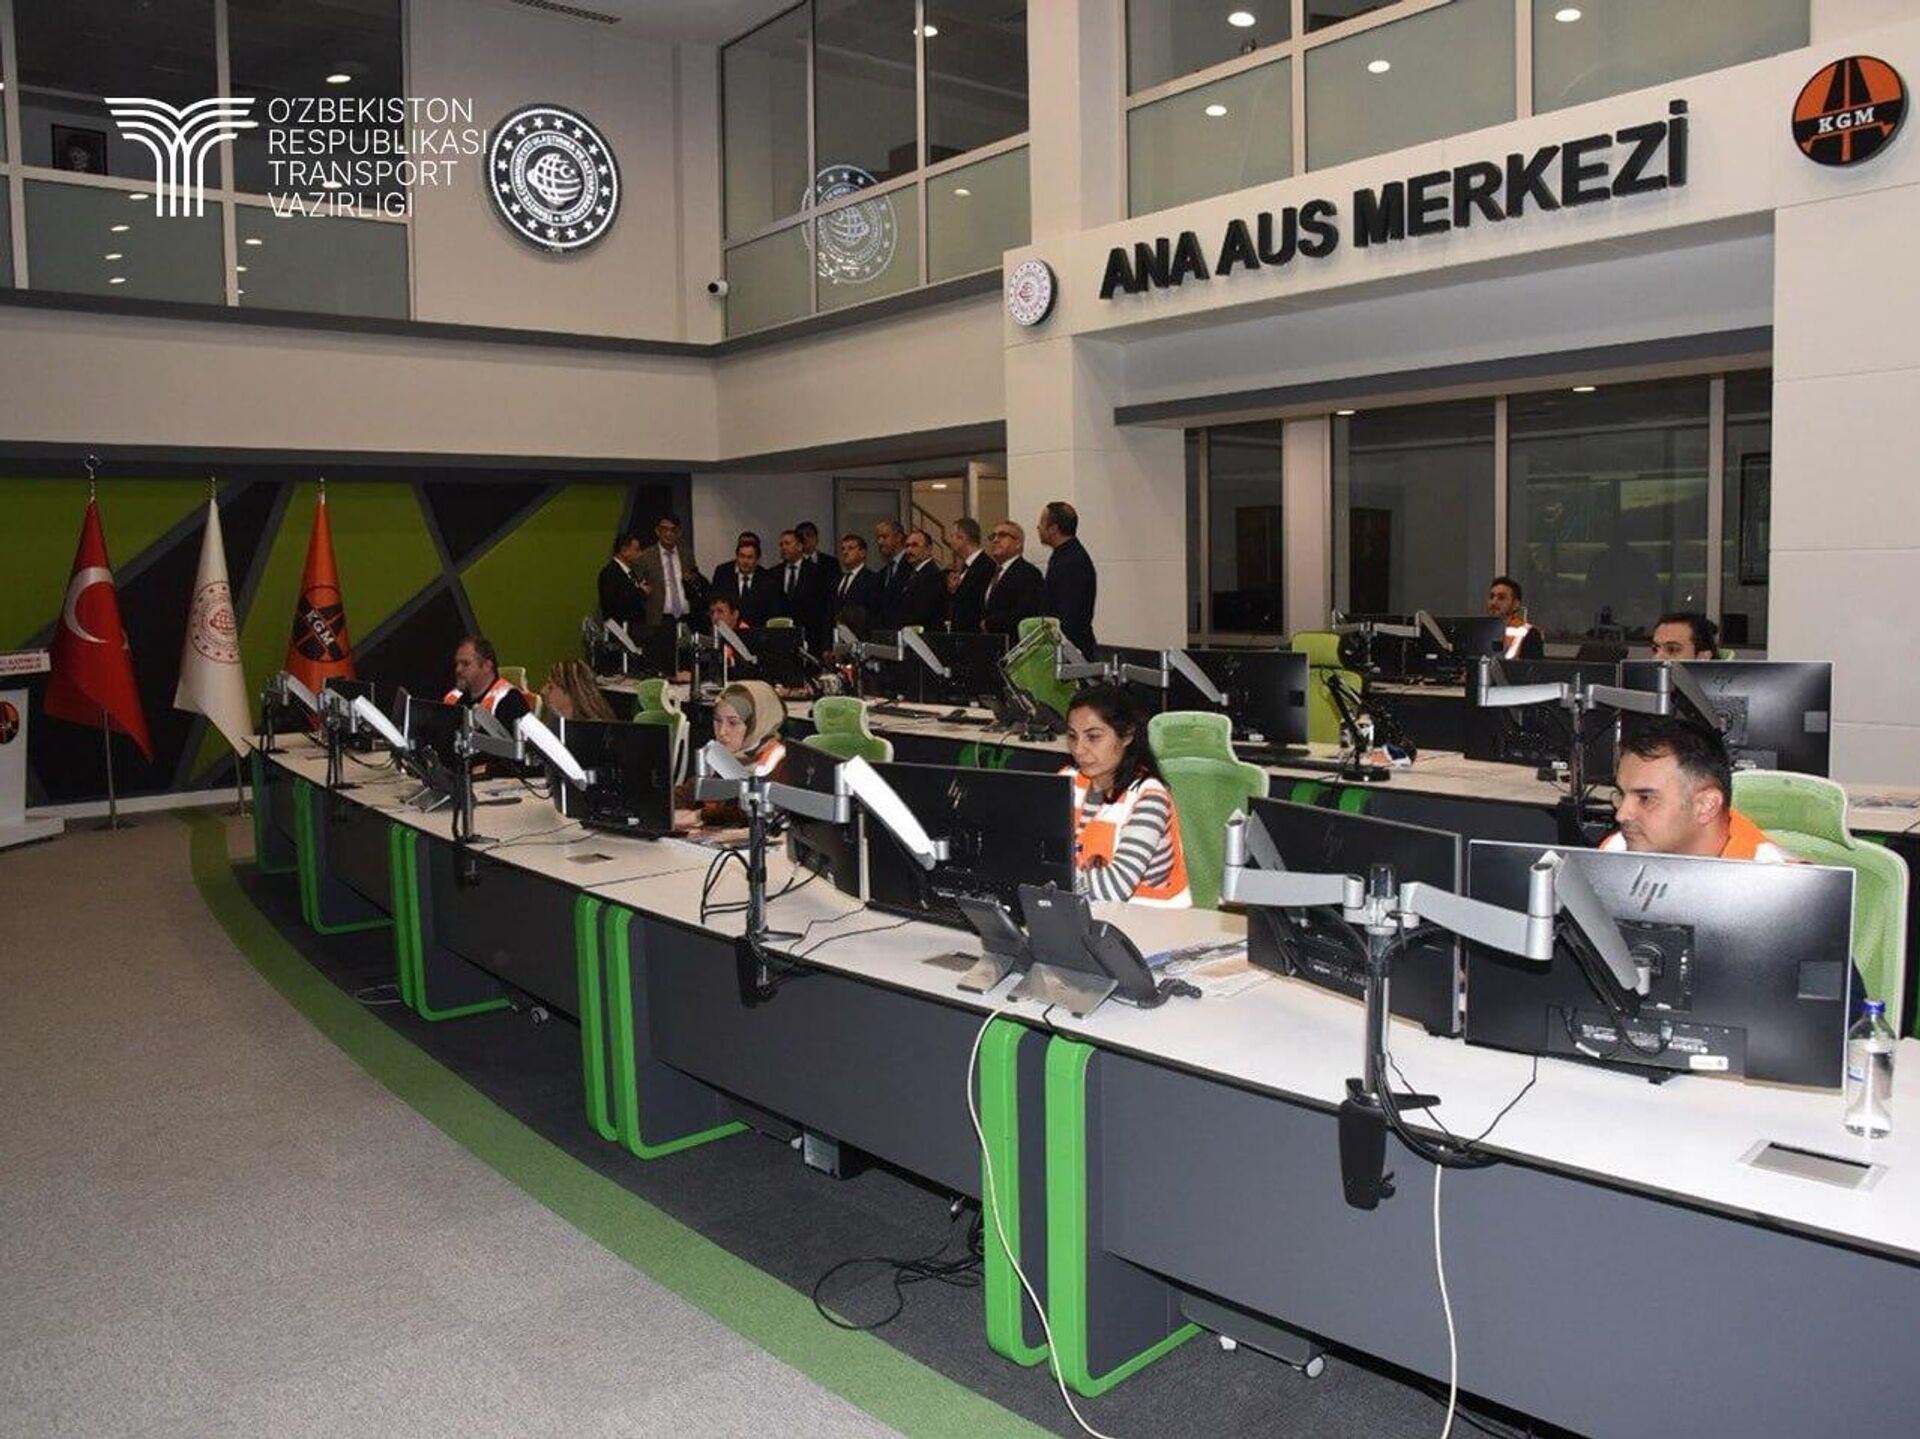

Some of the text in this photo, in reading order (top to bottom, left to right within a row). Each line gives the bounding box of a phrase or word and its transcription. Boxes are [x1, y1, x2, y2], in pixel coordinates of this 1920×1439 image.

[1817, 106, 1875, 135] KGM
[1099, 230, 1210, 300] ANA
[1215, 198, 1340, 276] AUS
[1352, 98, 1689, 248] MERKEZİ
[306, 608, 335, 646] KGM
